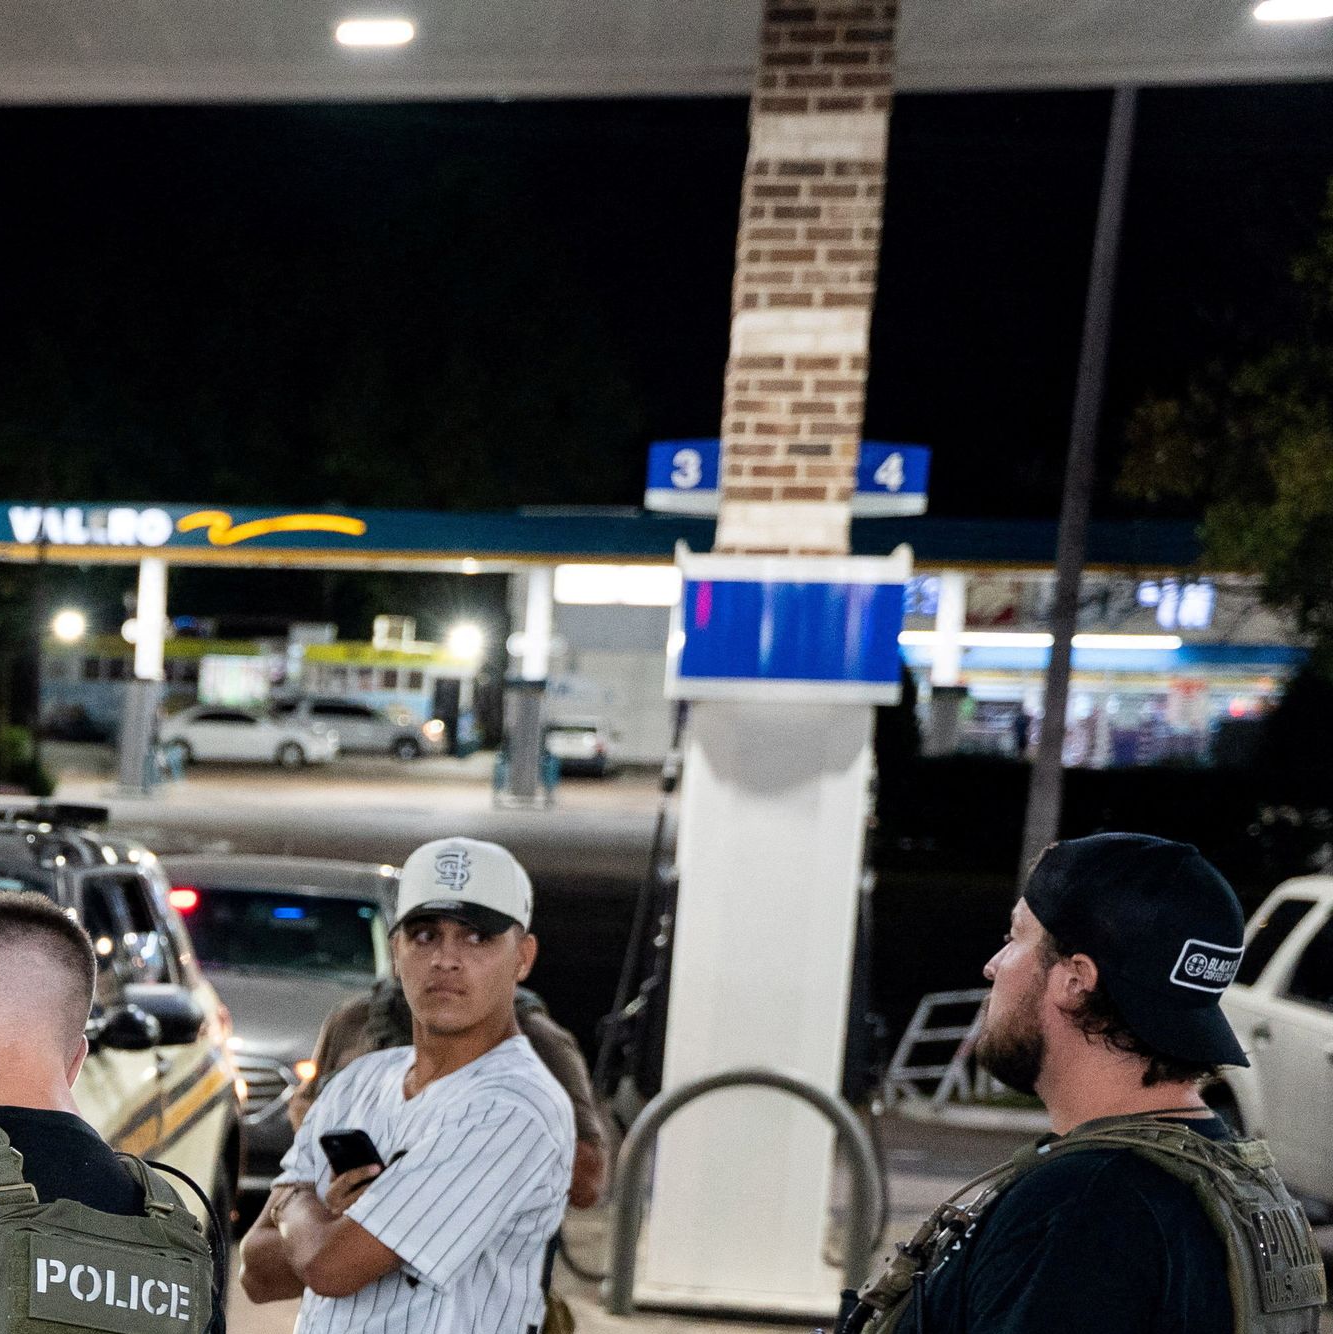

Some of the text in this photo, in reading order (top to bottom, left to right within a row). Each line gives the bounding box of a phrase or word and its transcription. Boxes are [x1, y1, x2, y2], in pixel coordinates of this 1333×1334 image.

[670, 448, 702, 490] 3
[873, 451, 905, 492] 4
[36, 1257, 190, 1321] POLICE
